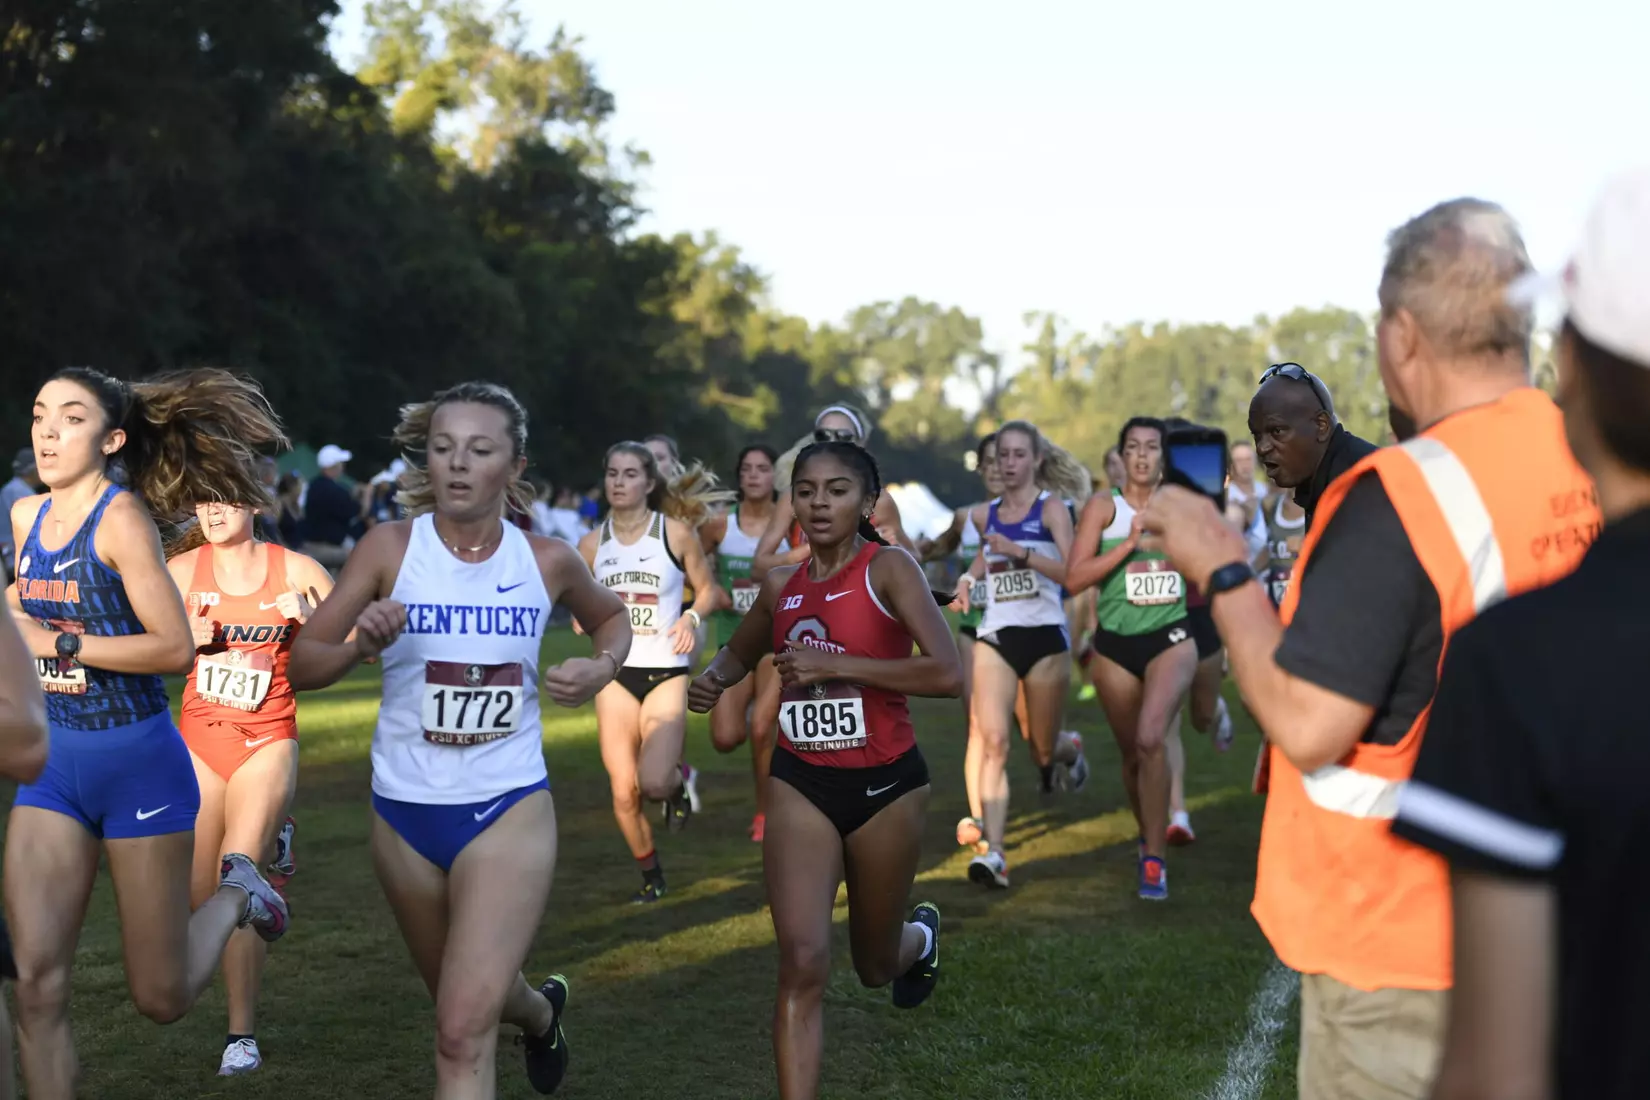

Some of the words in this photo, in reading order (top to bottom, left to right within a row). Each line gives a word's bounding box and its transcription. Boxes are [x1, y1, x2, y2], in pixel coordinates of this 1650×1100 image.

[601, 571, 622, 588] AKE
[623, 570, 661, 588] FOREST
[994, 571, 1033, 595] 2095
[1132, 574, 1177, 597] 2072
[17, 577, 80, 604] FLORIDA
[737, 591, 758, 609] 20
[400, 604, 540, 637] KENTUCKY
[631, 607, 653, 627] 82
[213, 624, 294, 644] INOIS
[49, 683, 79, 693] INVITE
[205, 665, 260, 701] 1731
[433, 689, 513, 729] 1772
[787, 702, 857, 738] 1895
[456, 734, 471, 744] XC
[823, 739, 859, 750] INVITE
